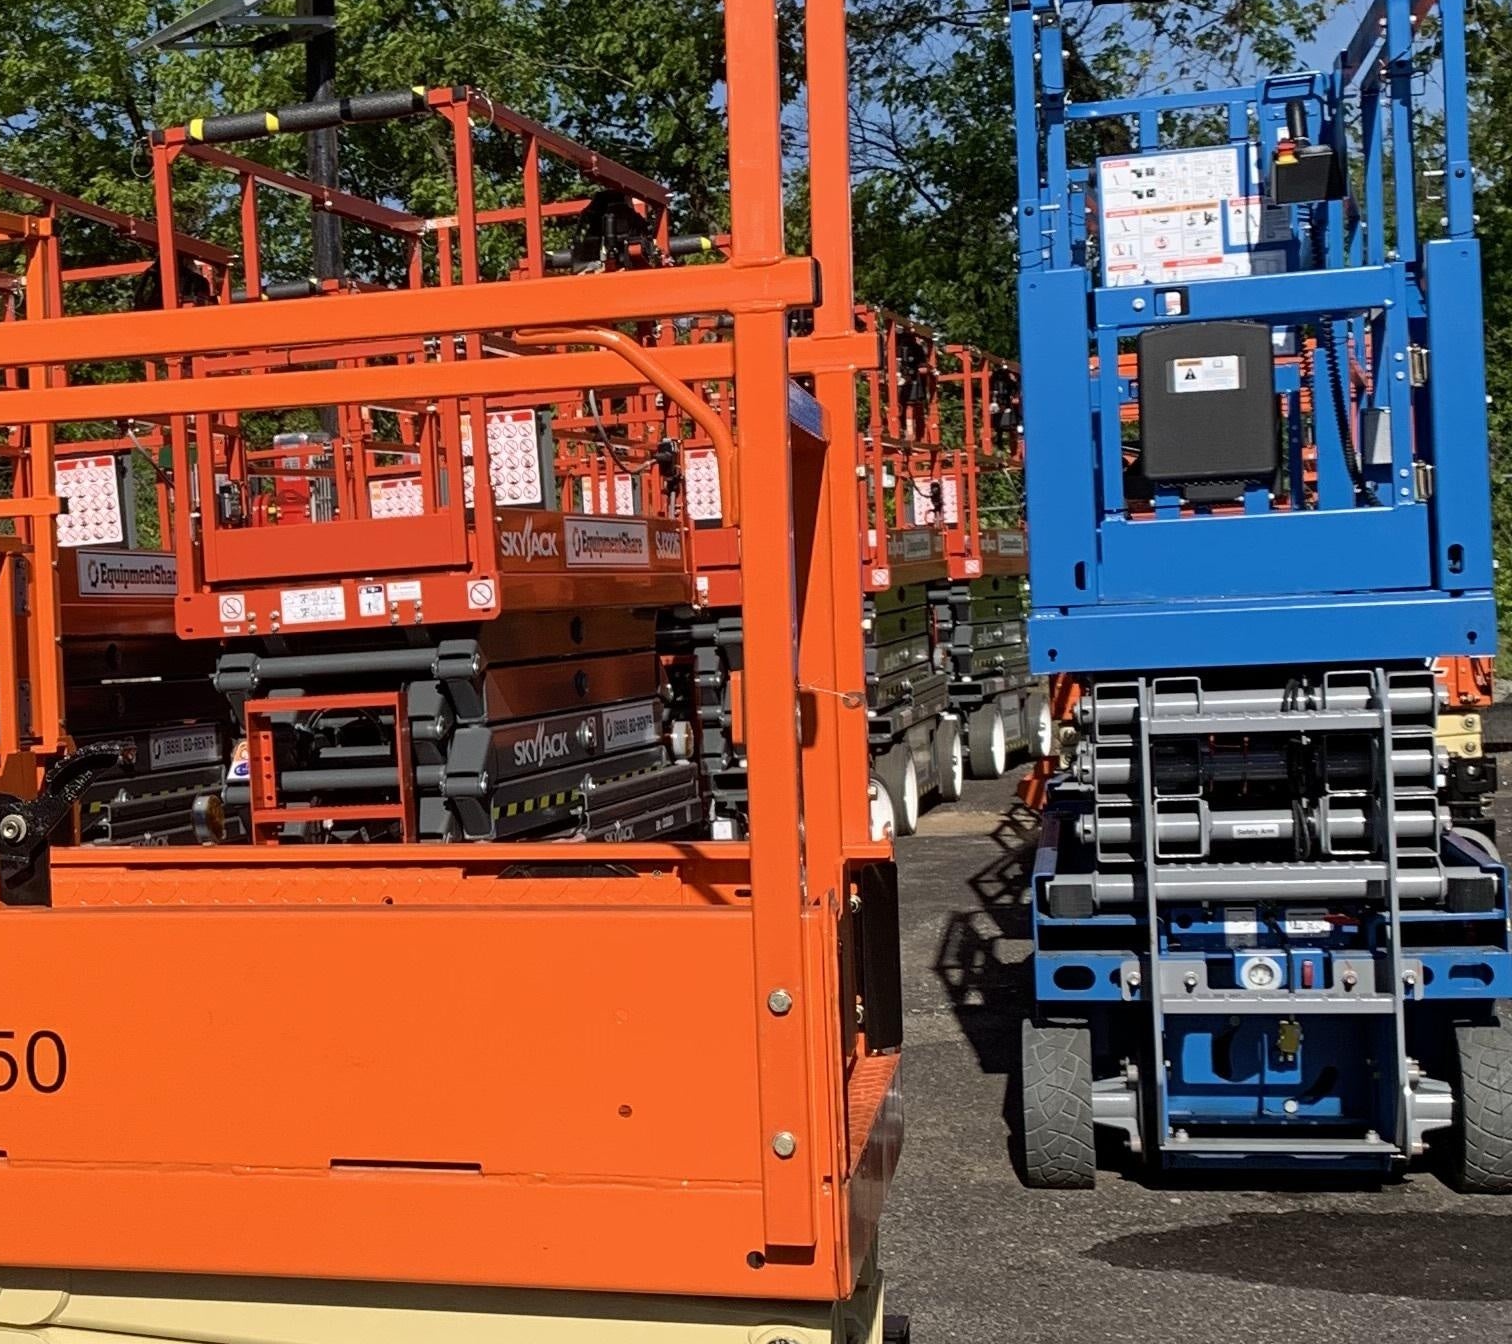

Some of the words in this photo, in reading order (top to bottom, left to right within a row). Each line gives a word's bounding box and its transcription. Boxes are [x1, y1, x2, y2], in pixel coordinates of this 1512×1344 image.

[500, 515, 559, 562] SKYJACK
[581, 529, 643, 558] EquipmentShare
[513, 721, 570, 767] SKYJACK
